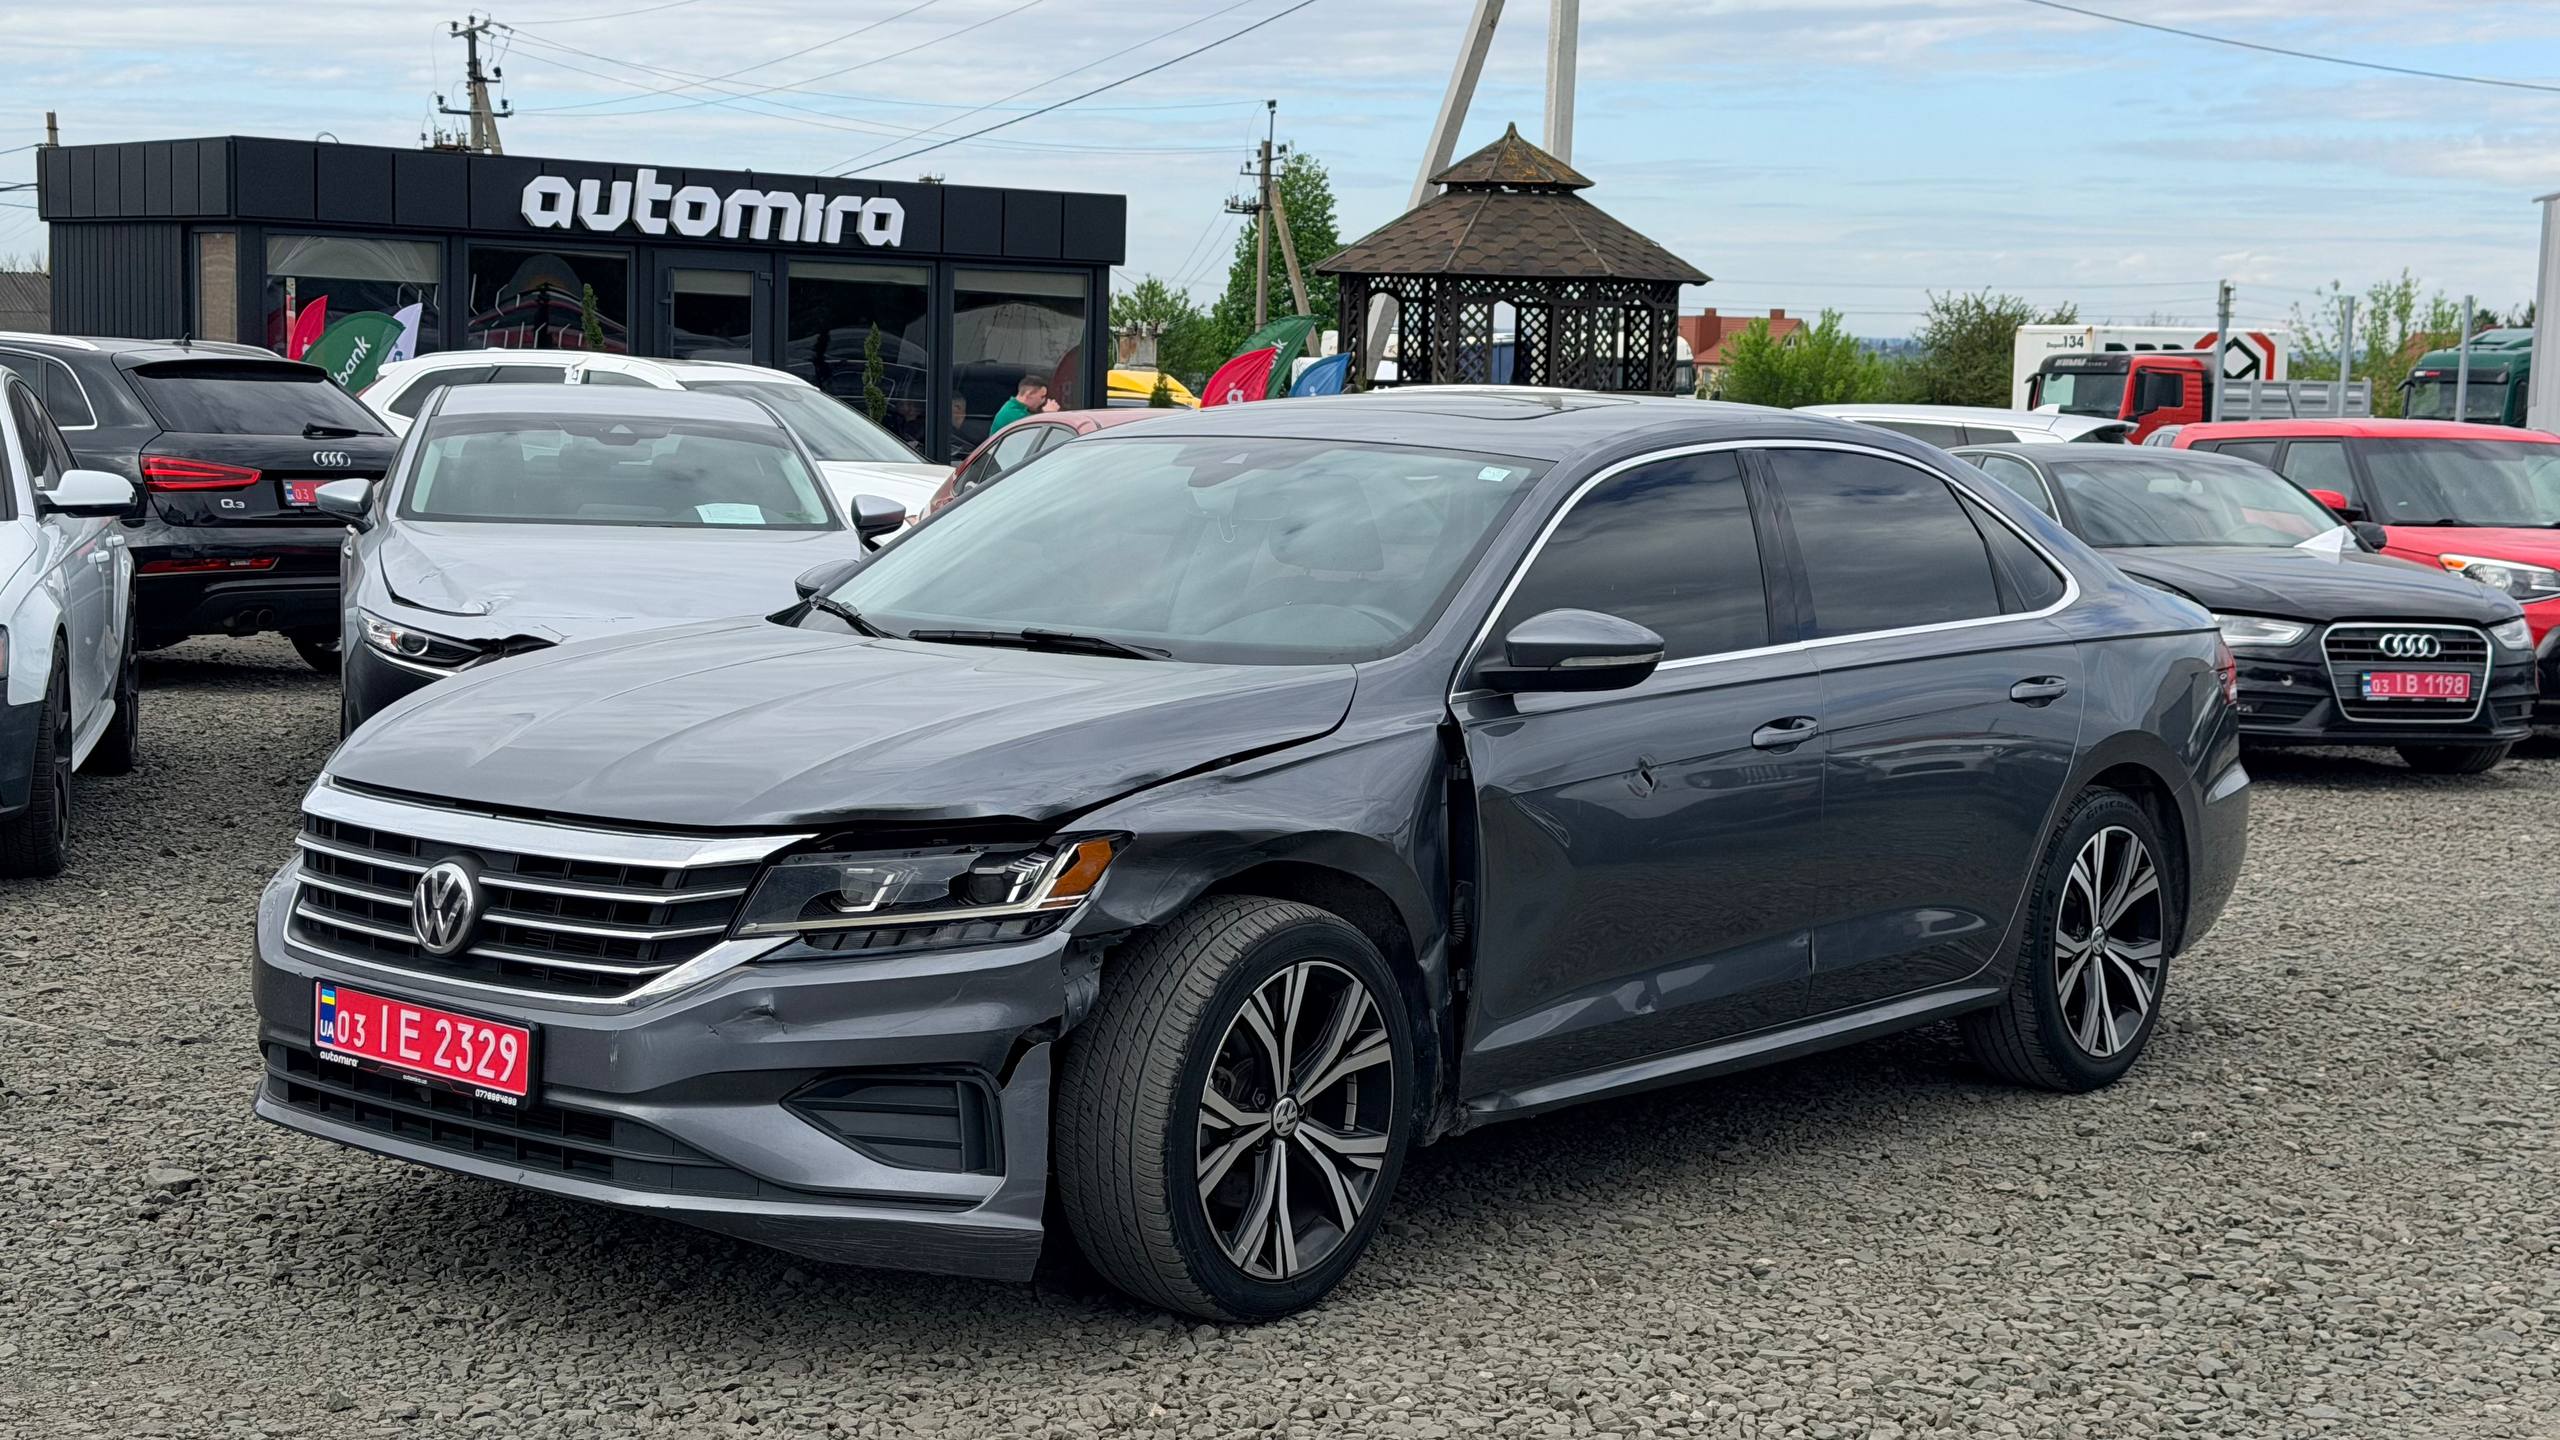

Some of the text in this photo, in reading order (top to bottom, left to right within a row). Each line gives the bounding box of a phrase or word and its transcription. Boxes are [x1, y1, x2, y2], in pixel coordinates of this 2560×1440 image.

[520, 168, 905, 248] automira
[2064, 335, 2084, 348] 134
[333, 335, 372, 387] bank
[220, 498, 245, 508] Q3
[2372, 679, 2389, 692] 03
[2425, 675, 2464, 695] 1198
[320, 1019, 334, 1039] UA
[337, 1010, 366, 1048] 03
[434, 1018, 518, 1082] 2329
